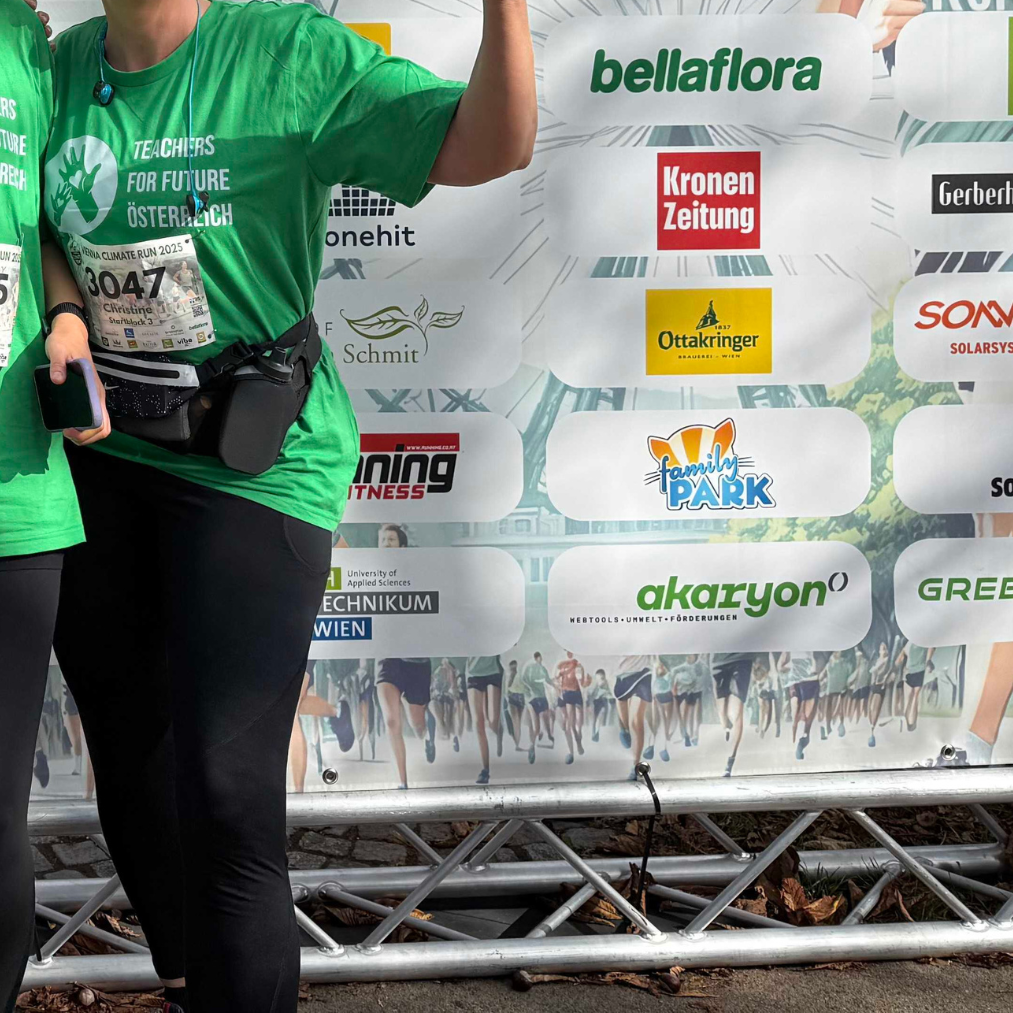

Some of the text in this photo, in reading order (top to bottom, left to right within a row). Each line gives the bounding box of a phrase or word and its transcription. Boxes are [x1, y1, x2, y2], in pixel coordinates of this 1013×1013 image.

[589, 47, 823, 94] bellaflora
[133, 134, 215, 160] TEACHERS
[126, 168, 231, 193] FOR FUTURE
[662, 165, 755, 196] Kronen
[662, 200, 755, 234] Zeitung
[101, 250, 136, 261] CLIMATE
[137, 247, 158, 259] RUN
[159, 242, 183, 256] 2025
[84, 266, 166, 300] 3047
[103, 302, 153, 316] Christine
[109, 316, 147, 326] Startblock
[658, 330, 759, 352] Ottakringer
[343, 342, 419, 364] Schmit
[659, 444, 738, 492] family
[669, 476, 773, 507] PARK
[347, 569, 397, 578] University of
[347, 579, 411, 589] Applied Sciences
[313, 620, 366, 637] WIEN
